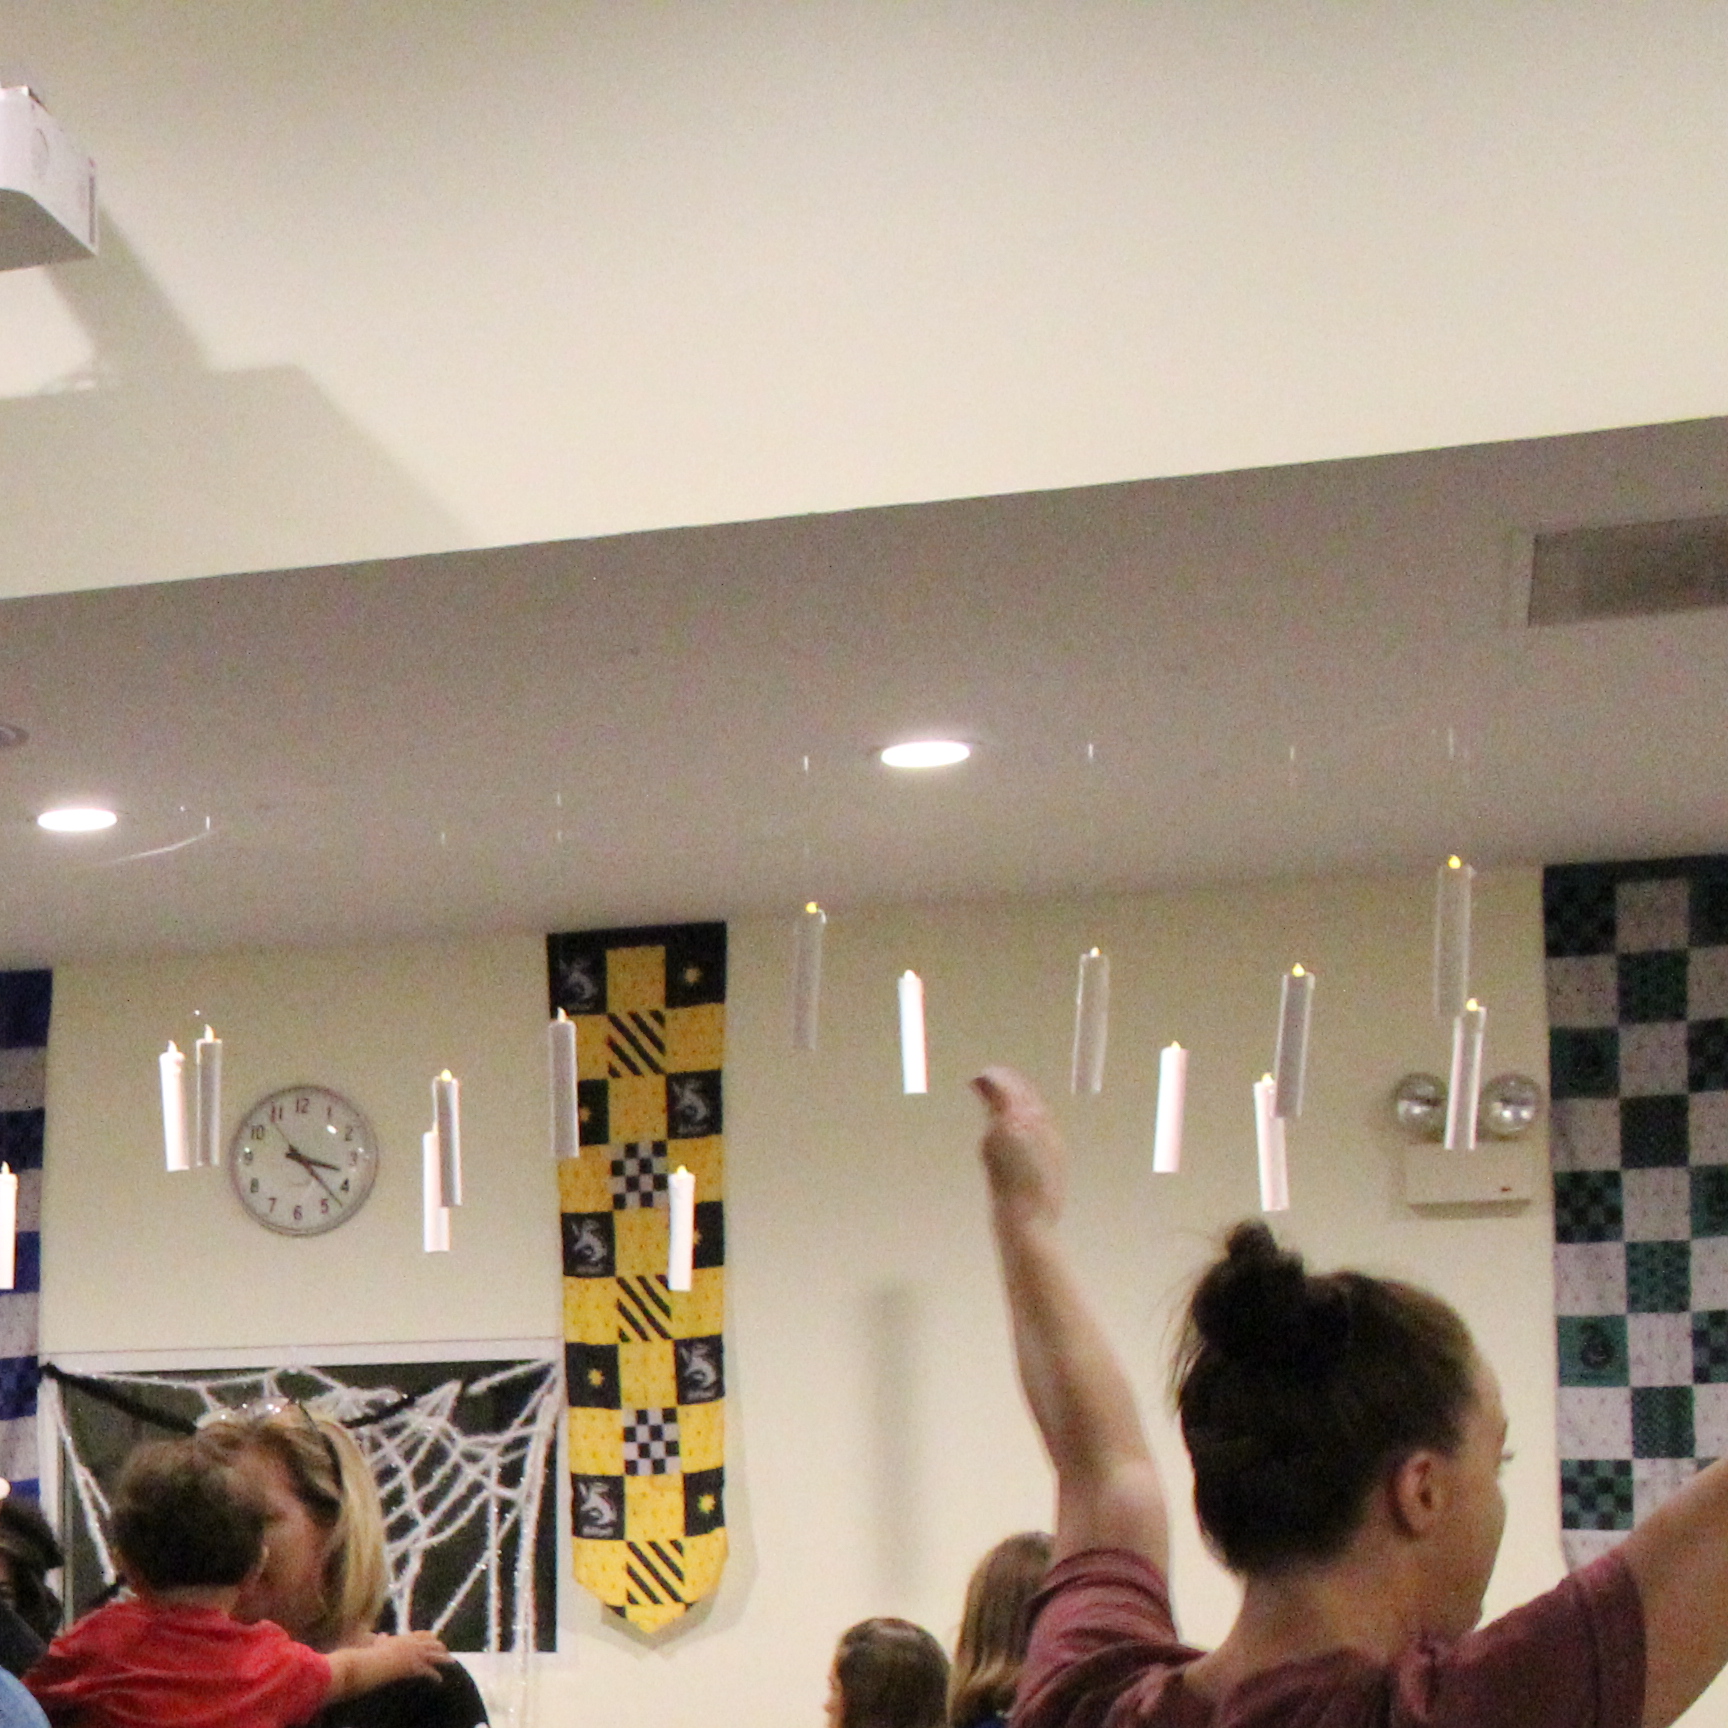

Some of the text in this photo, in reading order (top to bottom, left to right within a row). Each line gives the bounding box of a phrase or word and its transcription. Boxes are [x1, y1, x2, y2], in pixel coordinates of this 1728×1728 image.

[270, 1105, 283, 1122] 11
[295, 1098, 310, 1114] 12
[251, 1124, 265, 1140] 10
[344, 1126, 353, 1142] 2
[340, 1178, 350, 1193] 4
[268, 1197, 277, 1213] 7
[293, 1205, 302, 1221] 6
[320, 1198, 329, 1214] 5
